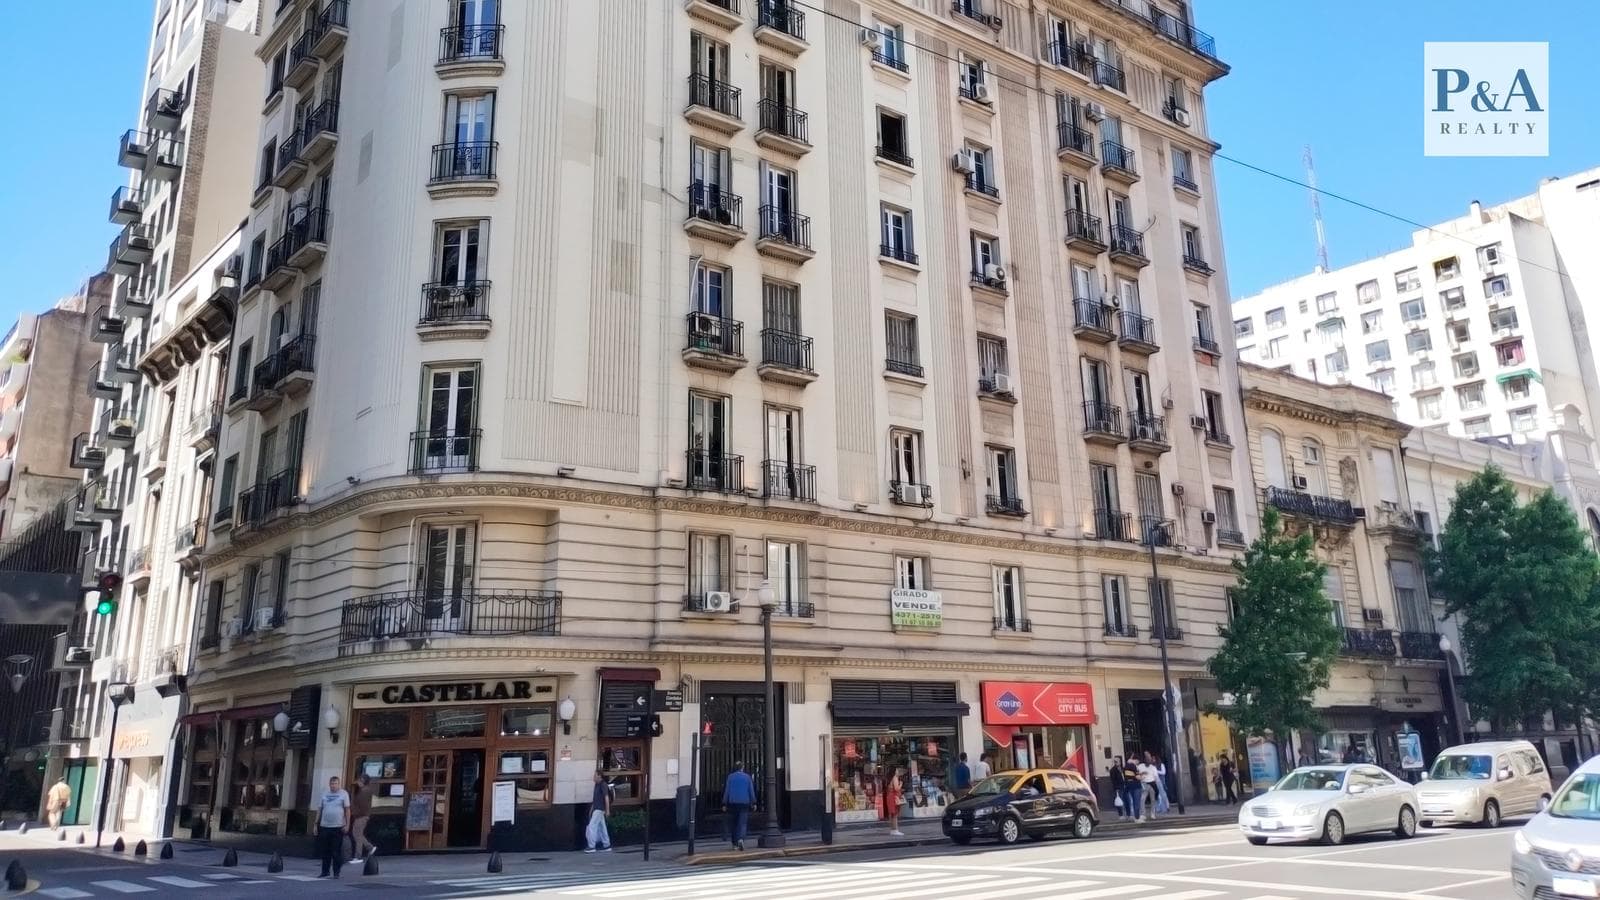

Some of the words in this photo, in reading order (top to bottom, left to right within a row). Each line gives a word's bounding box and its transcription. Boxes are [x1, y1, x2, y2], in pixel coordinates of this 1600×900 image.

[893, 590, 928, 598] GIRADO
[894, 602, 937, 610] VENDE
[382, 681, 532, 704] CASTELAR
[1058, 704, 1074, 712] CITY
[1074, 704, 1088, 712] BUS
